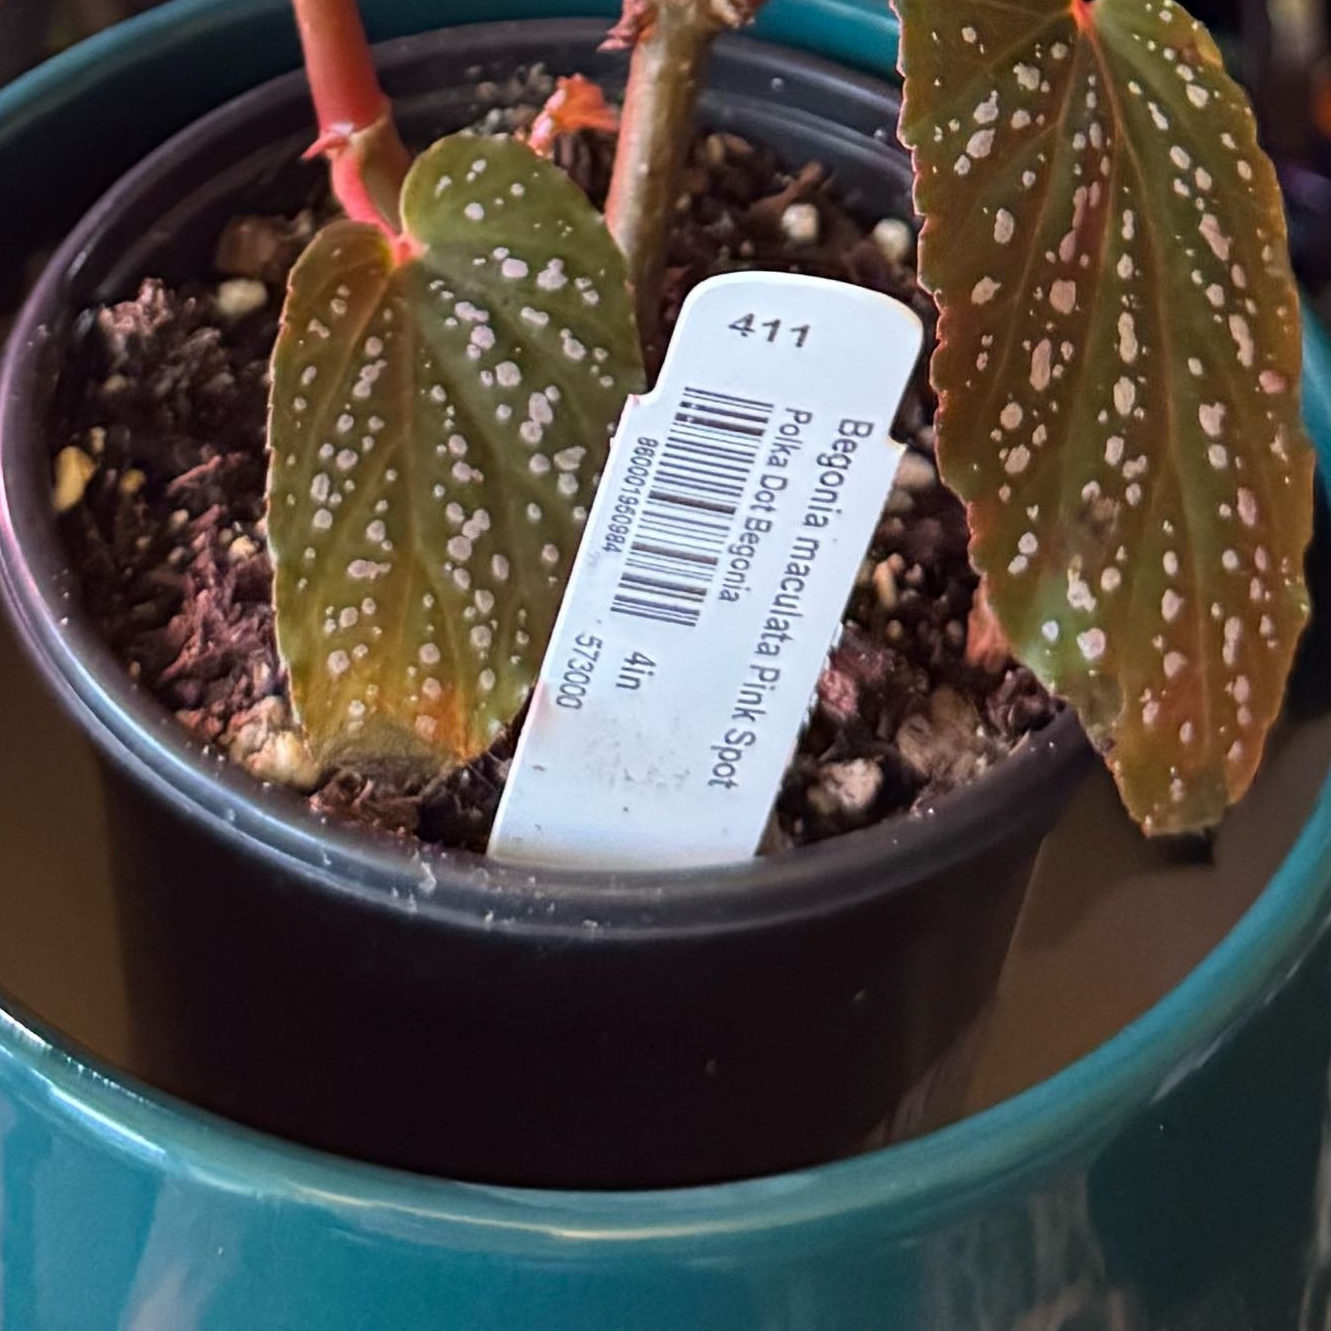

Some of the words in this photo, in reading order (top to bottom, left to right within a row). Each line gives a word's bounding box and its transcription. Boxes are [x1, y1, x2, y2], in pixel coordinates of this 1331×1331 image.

[726, 312, 811, 350] 411
[766, 407, 813, 469] Polka
[749, 473, 789, 513] Dot
[803, 419, 875, 528] Begonia
[717, 516, 773, 603] Begonia
[754, 536, 821, 656] maculata
[555, 633, 603, 711] 573000
[615, 650, 657, 691] 4in
[730, 664, 781, 723] Pink
[707, 727, 757, 790] Spot
